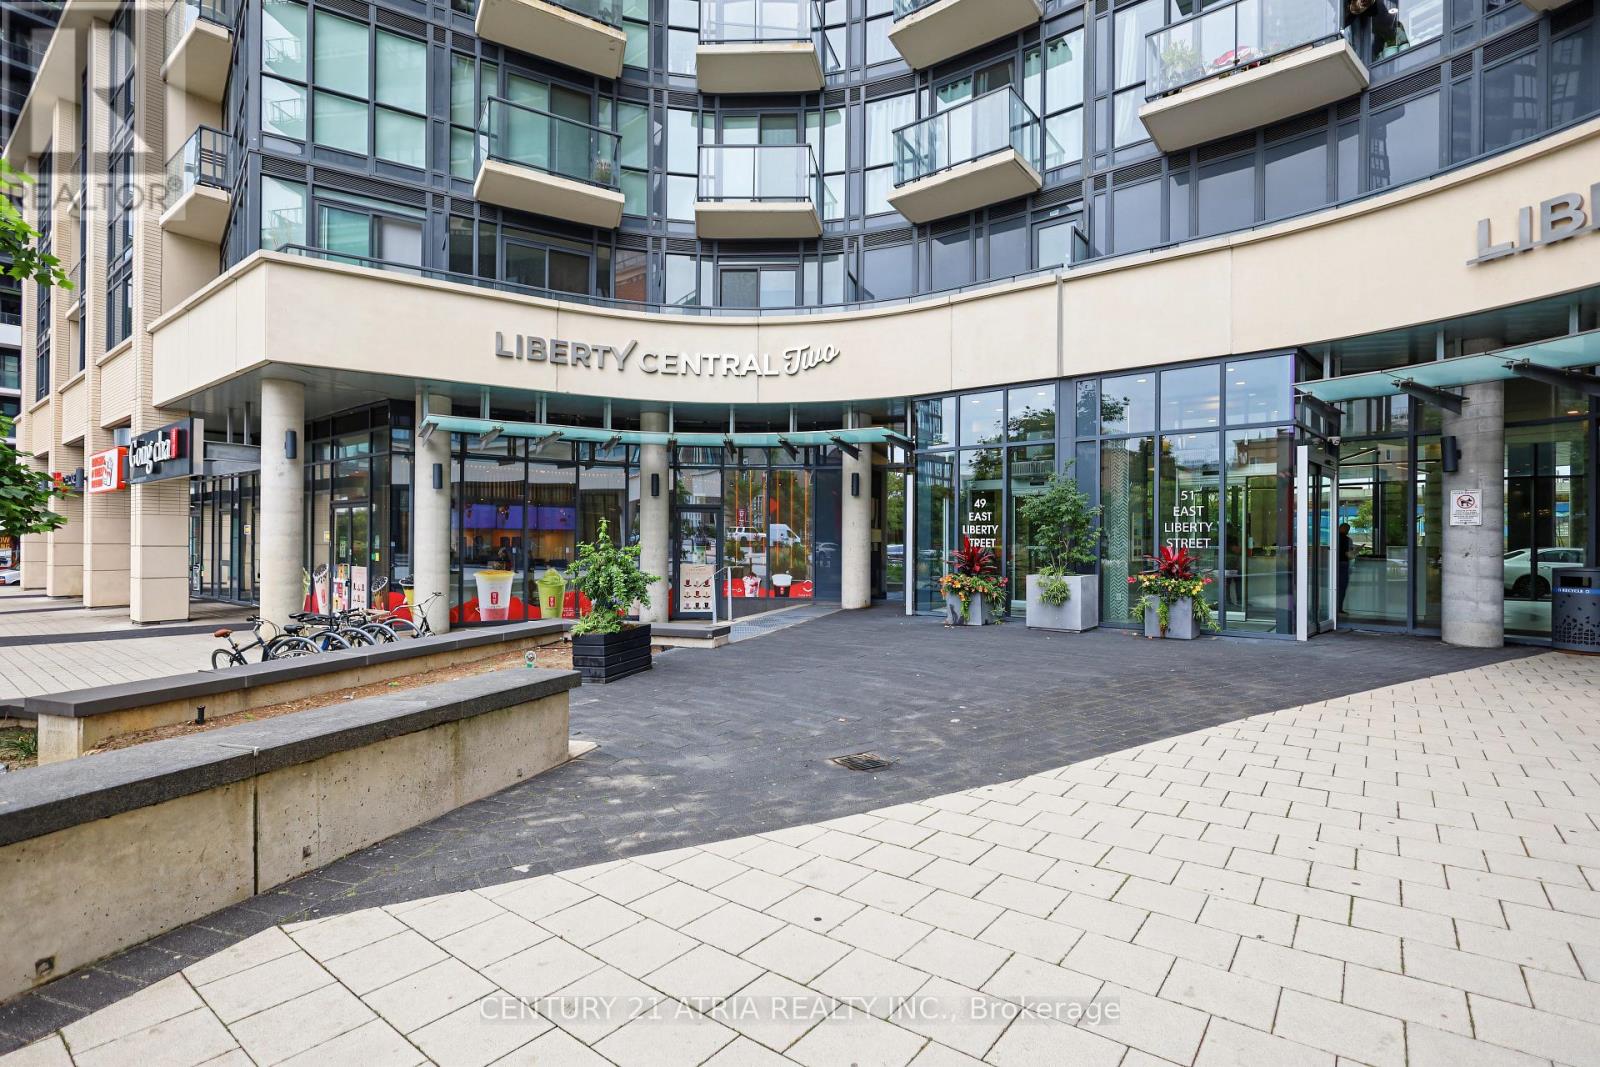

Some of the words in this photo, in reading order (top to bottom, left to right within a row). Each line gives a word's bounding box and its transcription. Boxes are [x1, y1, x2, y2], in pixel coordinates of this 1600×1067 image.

[1477, 182, 1600, 262] LIB
[495, 331, 638, 371] LIBERTY
[638, 352, 780, 377] CENTRAL
[783, 342, 841, 375] Two
[129, 437, 153, 474] Gong
[1180, 490, 1194, 501] 51
[974, 498, 987, 508] 49
[968, 511, 992, 521] EAST
[1173, 505, 1205, 517] EAST
[962, 524, 999, 534] LIBERTY
[1164, 522, 1213, 533] LIBERTY
[968, 538, 996, 548] TREET
[1166, 537, 1211, 549] STREET
